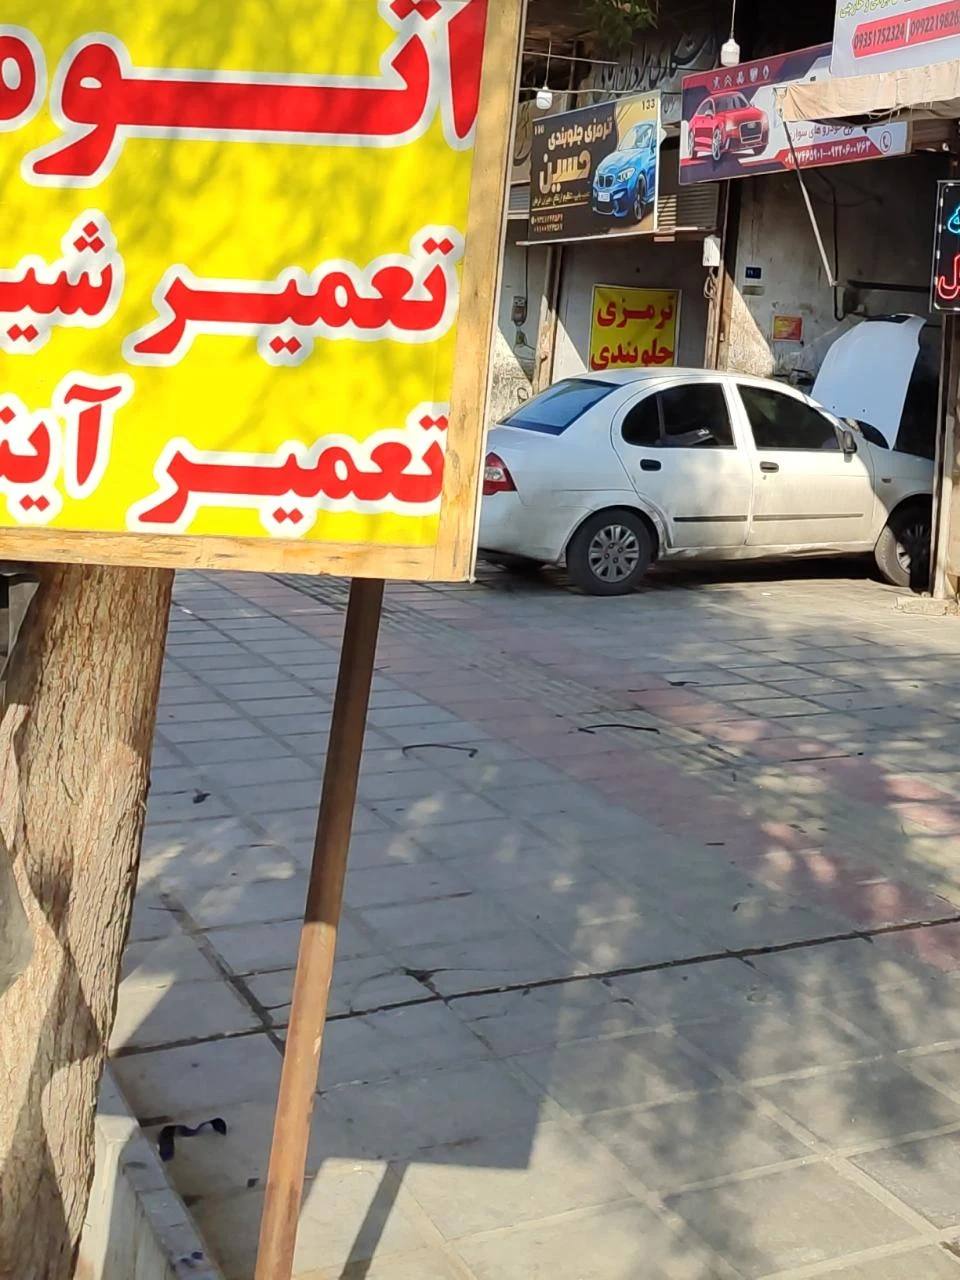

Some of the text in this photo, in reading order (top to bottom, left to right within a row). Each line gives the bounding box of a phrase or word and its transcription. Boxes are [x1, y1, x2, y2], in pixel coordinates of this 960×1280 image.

[547, 124, 584, 151] جلوبندی
[584, 116, 613, 144] ترمزی
[538, 150, 592, 195] حسین
[0, 220, 455, 356] تعمیر شی
[596, 295, 674, 329] ترمزی
[0, 383, 449, 525] تعمیر آین
